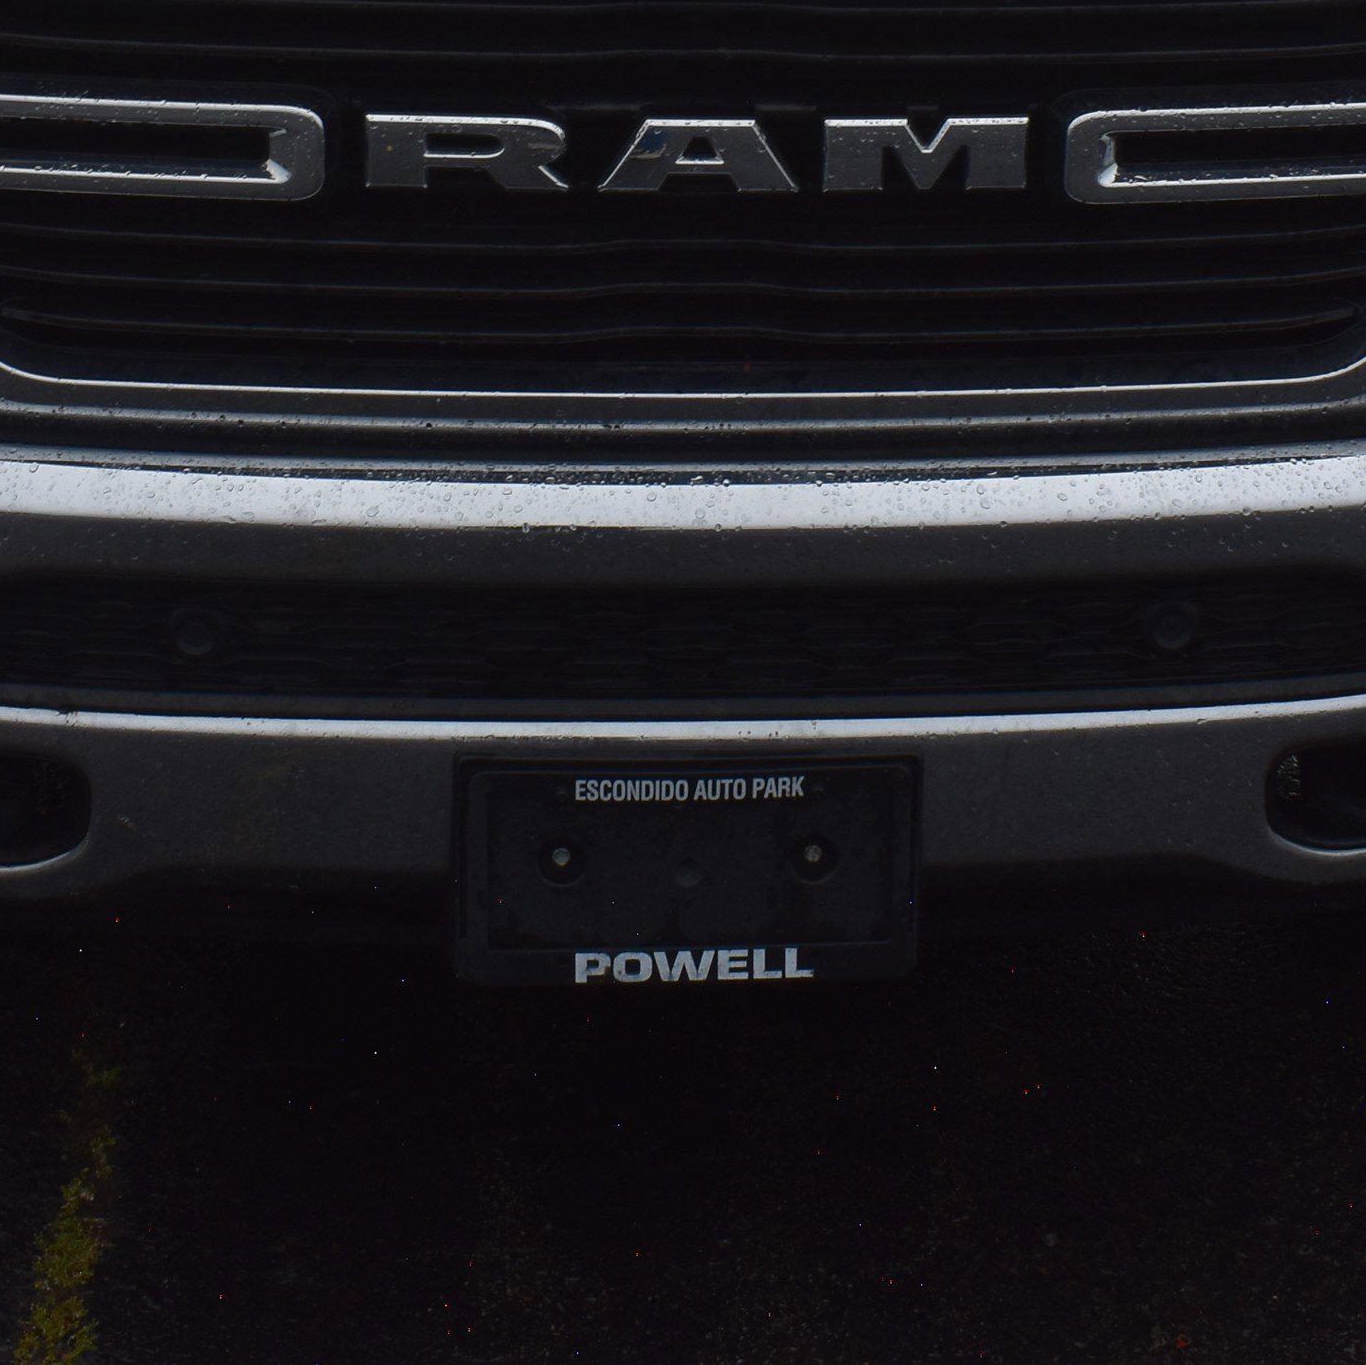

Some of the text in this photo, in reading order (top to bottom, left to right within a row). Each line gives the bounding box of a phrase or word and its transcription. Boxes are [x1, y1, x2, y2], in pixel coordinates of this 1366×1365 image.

[365, 113, 1030, 191] RAM
[574, 776, 805, 801] ESCONDIDO AUTO PARK
[574, 947, 815, 984] POWELL
